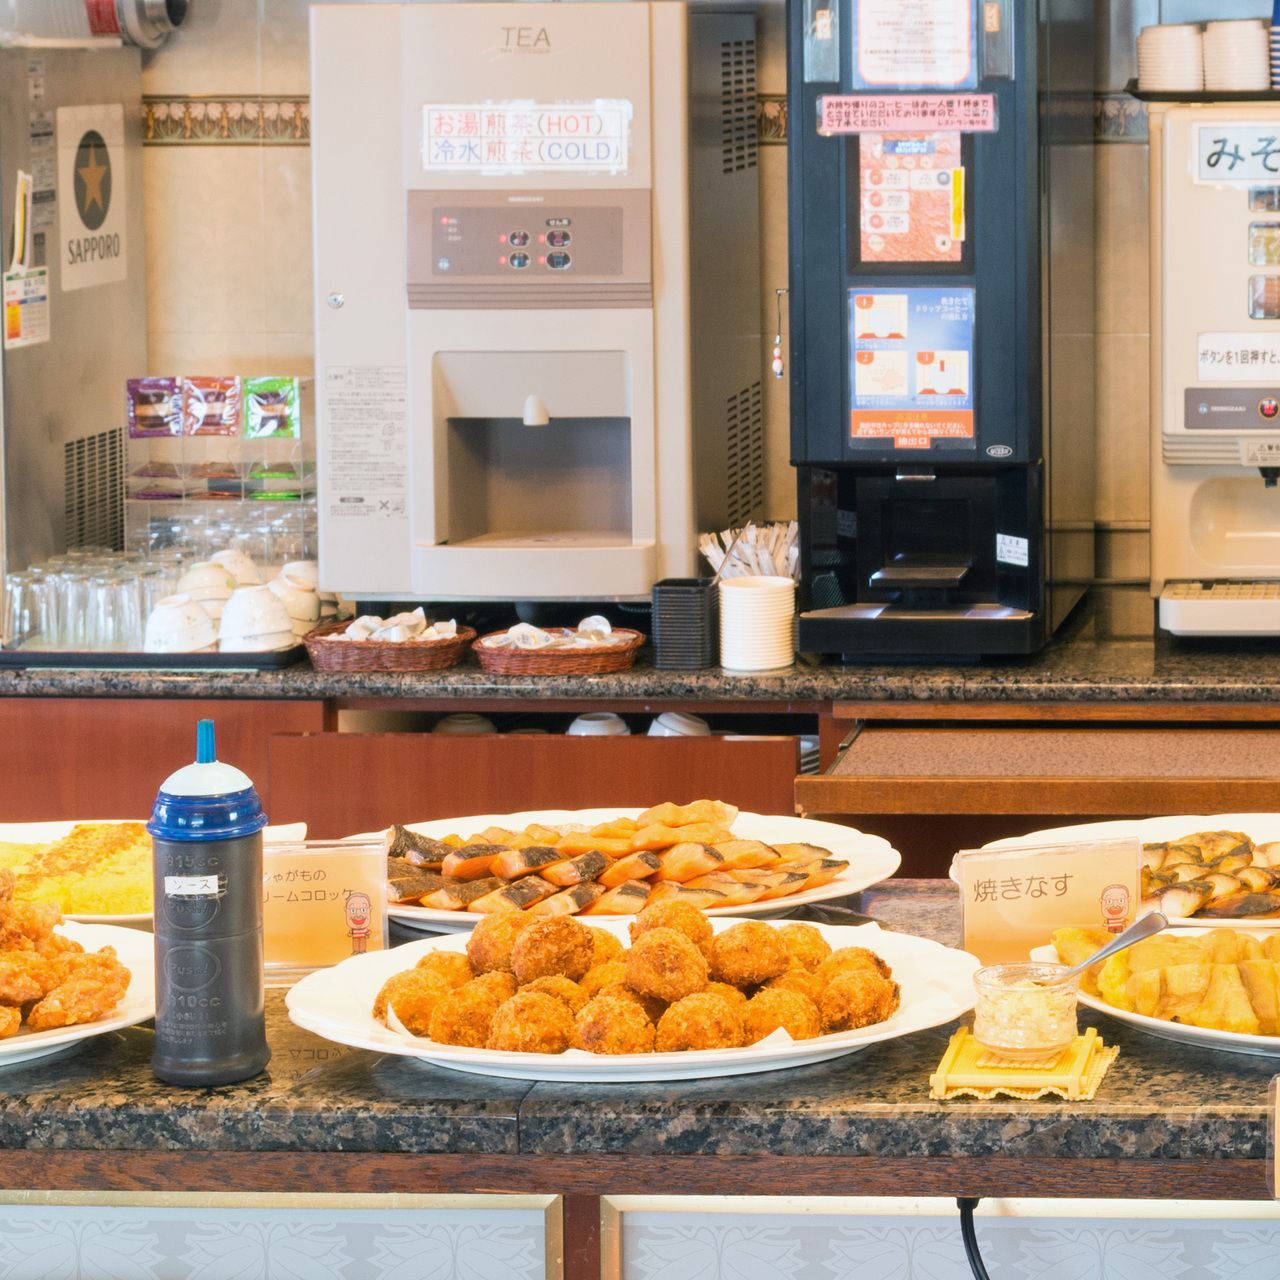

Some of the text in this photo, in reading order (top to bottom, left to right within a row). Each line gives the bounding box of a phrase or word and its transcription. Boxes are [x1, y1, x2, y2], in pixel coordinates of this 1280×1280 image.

[501, 27, 551, 47] TEA
[434, 113, 479, 136] お湯
[433, 139, 481, 162] 冷水
[67, 233, 121, 265] SAPPORO
[174, 879, 212, 891] ソース
[973, 872, 1074, 903] 焼きなす
